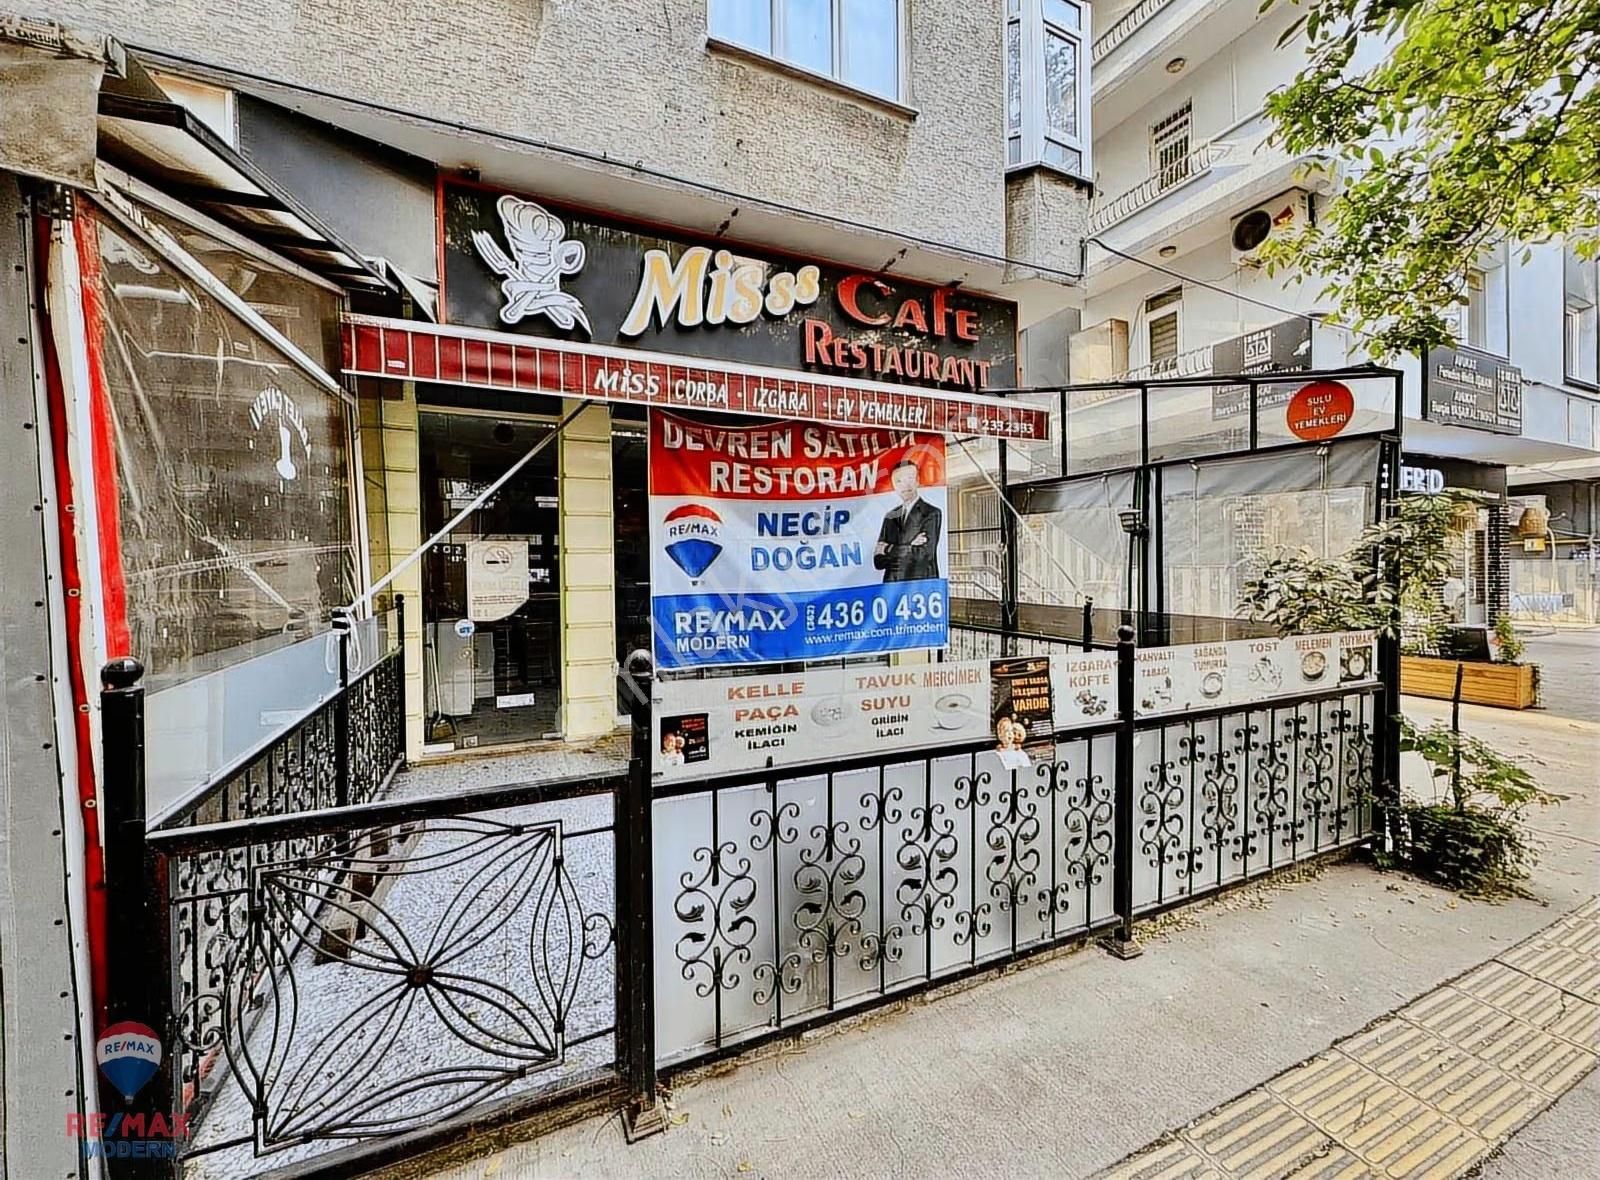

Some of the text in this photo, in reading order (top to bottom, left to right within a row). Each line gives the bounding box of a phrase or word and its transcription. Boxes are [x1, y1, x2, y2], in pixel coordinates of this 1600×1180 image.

[837, 398, 855, 416] EV
[1307, 394, 1332, 407] SULU
[1313, 405, 1326, 416] EV
[663, 418, 792, 459] DEVREN
[710, 459, 880, 496] RESTORAN
[757, 505, 851, 537] NECİP
[669, 523, 720, 538] RE/MAX
[751, 540, 863, 571] DOĞAN
[818, 600, 864, 629] 436
[872, 597, 888, 624] 0
[895, 592, 942, 621] 436
[675, 608, 786, 634] RE/MAX
[676, 634, 750, 653] MODERN
[1249, 642, 1279, 653] TOST
[856, 672, 916, 689] TAVUK
[923, 666, 982, 688] MERCİMEK
[728, 682, 805, 700] KELLE
[861, 695, 911, 711] SUYU
[1012, 697, 1050, 712] VARDIR
[735, 705, 799, 722] PAÇA
